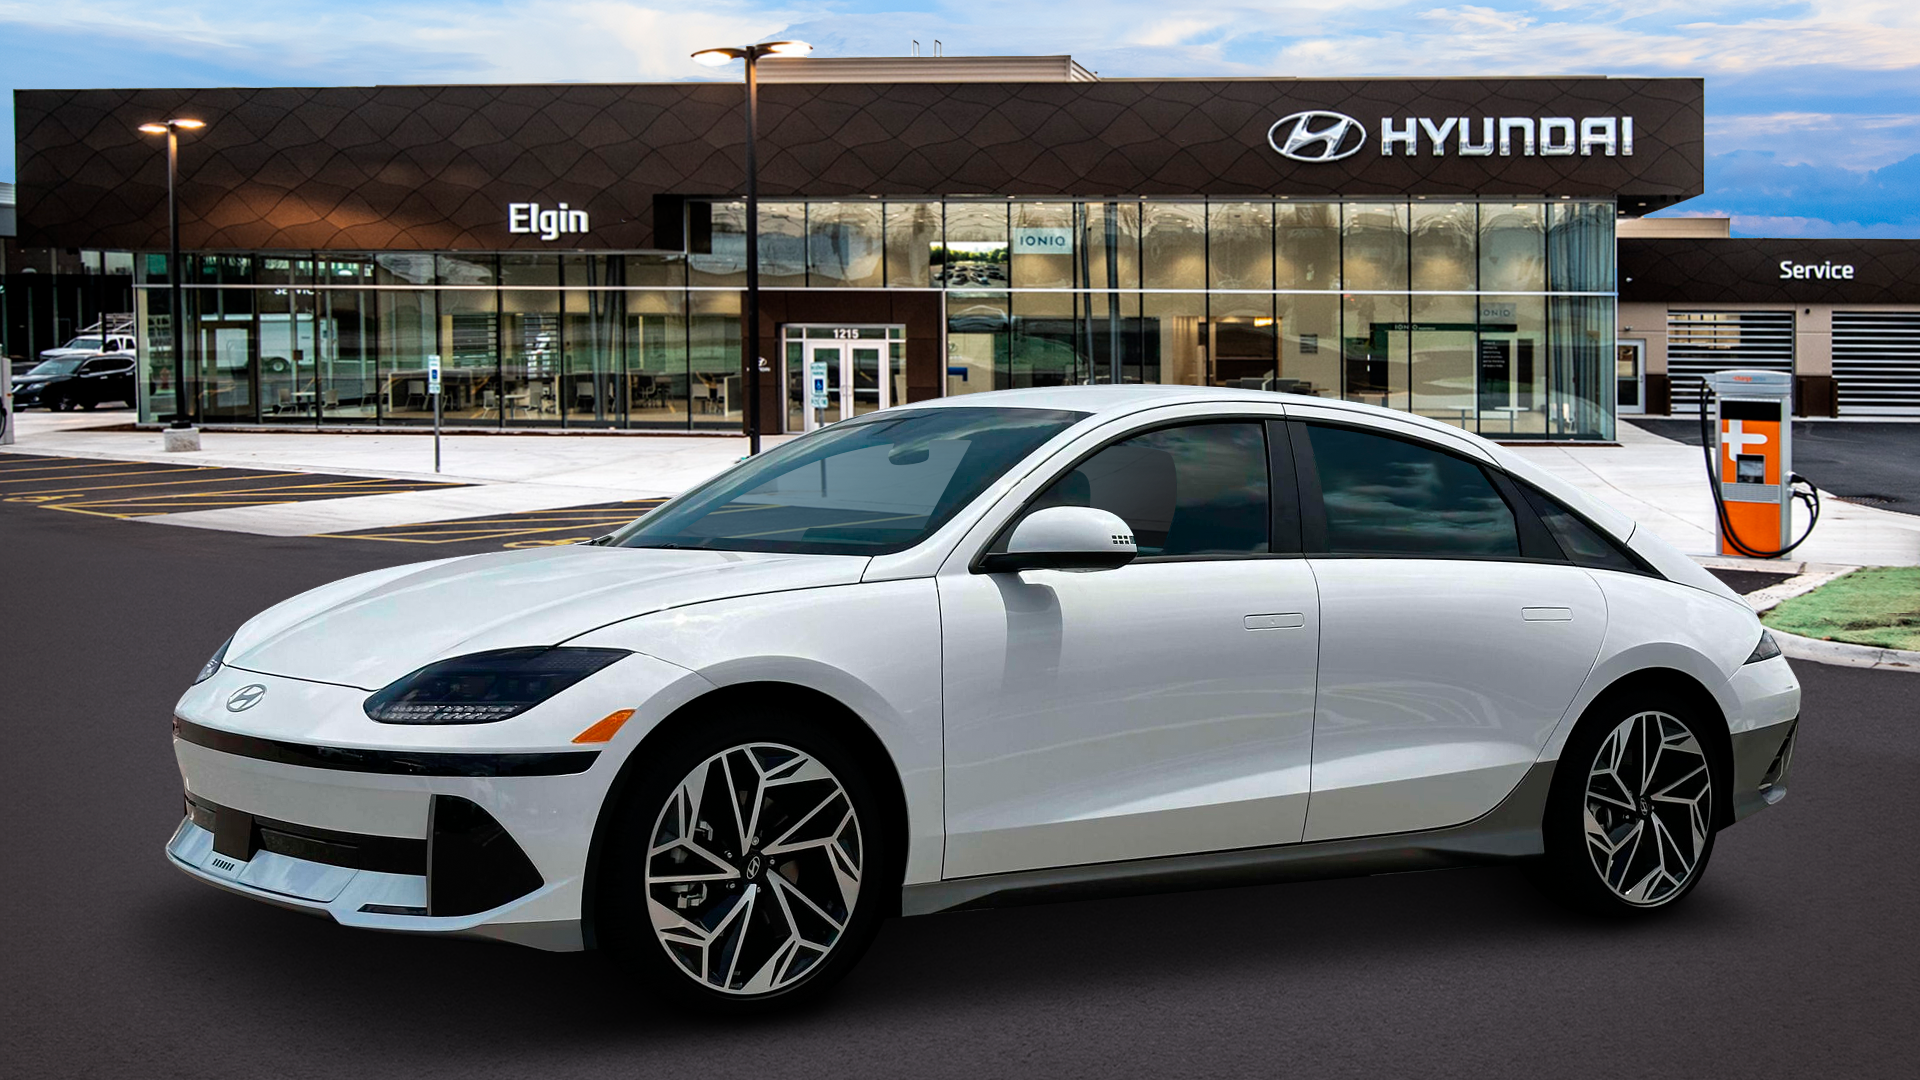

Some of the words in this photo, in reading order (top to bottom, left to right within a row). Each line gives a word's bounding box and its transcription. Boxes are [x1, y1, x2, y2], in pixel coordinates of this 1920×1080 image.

[1381, 116, 1633, 156] HYUNDAI
[509, 202, 589, 240] Elgin
[1020, 235, 1066, 247] IONIQ
[1779, 260, 1855, 279] Service
[833, 328, 860, 339] 1215
